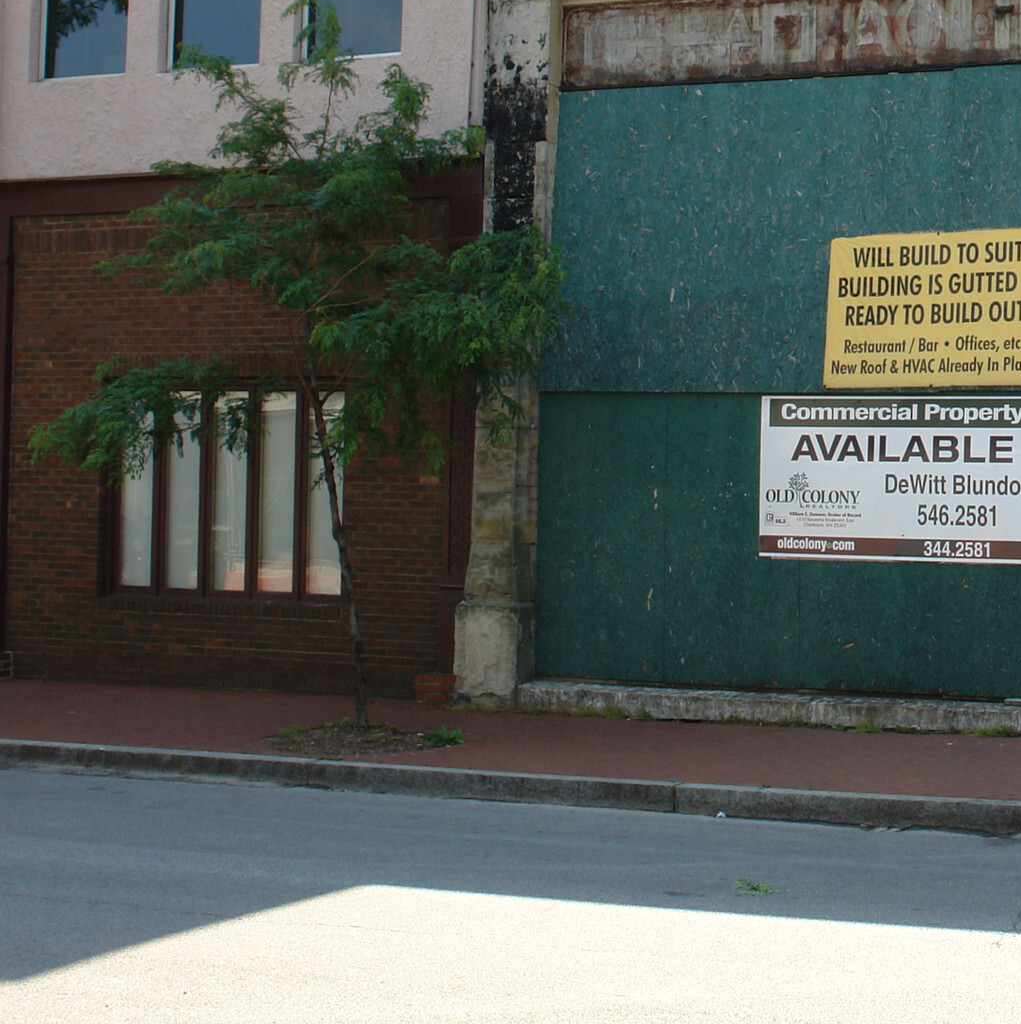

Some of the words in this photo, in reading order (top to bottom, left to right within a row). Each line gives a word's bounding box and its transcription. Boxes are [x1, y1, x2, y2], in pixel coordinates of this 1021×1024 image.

[853, 247, 894, 268] WILL
[900, 244, 951, 266] BUILD
[957, 243, 979, 264] TO
[838, 275, 922, 298] BUILDING
[928, 274, 943, 295] IS
[948, 272, 1017, 294] GUTTED
[845, 305, 899, 326] READY
[903, 304, 924, 325] TO
[930, 302, 983, 324] BUILD
[843, 339, 906, 354] Restaurant
[918, 338, 939, 353] Bar
[955, 335, 999, 352] Offices,
[831, 360, 857, 374] New
[860, 359, 886, 374] Roof
[890, 359, 899, 373] &
[902, 358, 935, 374] HVAC
[938, 357, 983, 376] Already
[987, 357, 999, 372] In
[781, 403, 918, 421] Commercial
[790, 434, 1014, 463] AVAILABLE
[884, 473, 947, 495] DeWitt
[766, 489, 795, 503] OLD
[801, 489, 860, 504] COLONY
[917, 504, 998, 527] 546.2581
[777, 537, 855, 552] oldcolony.com
[923, 540, 991, 558] 344.2581
